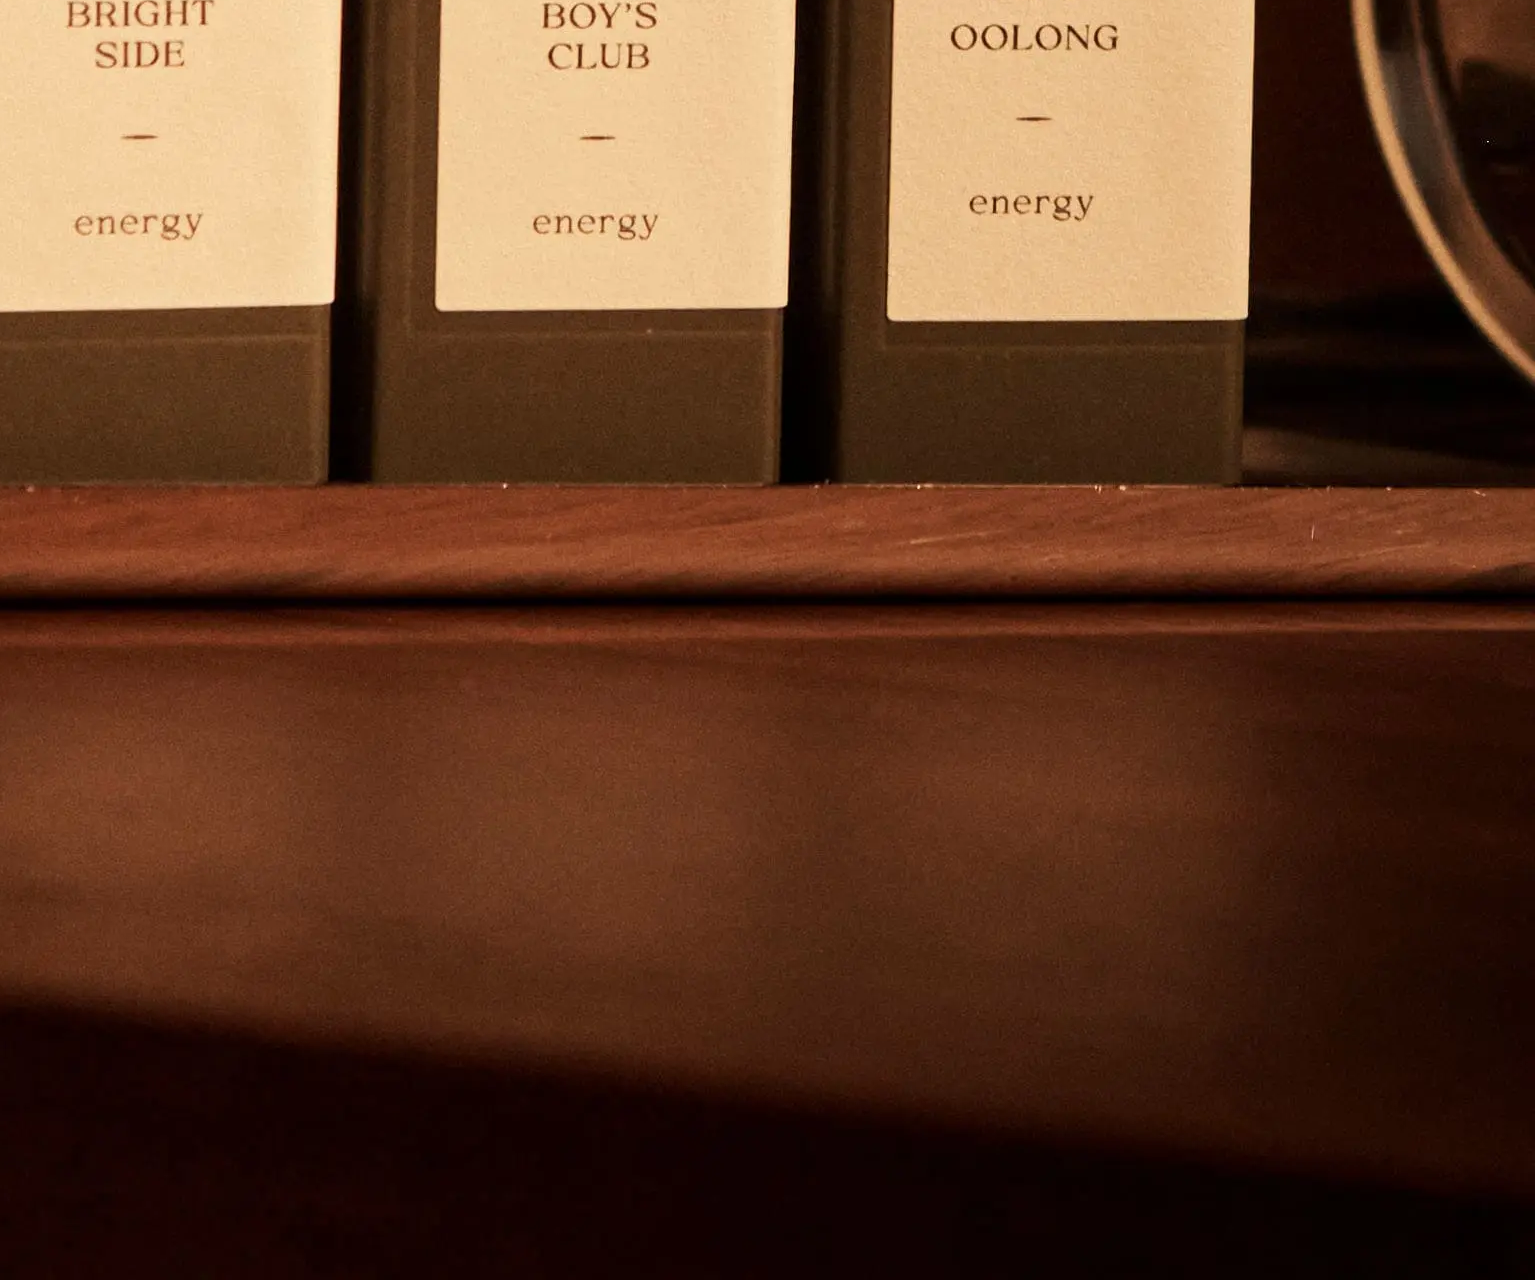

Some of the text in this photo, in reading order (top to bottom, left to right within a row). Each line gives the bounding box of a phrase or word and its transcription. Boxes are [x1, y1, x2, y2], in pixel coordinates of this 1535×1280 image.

[542, 0, 659, 30] BOY'S
[950, 23, 1120, 52] OOLONG
[95, 40, 186, 69] SIDE
[547, 42, 652, 71] CLUB
[968, 192, 1096, 223] energy
[73, 211, 204, 241] energy
[532, 211, 660, 241] energy
